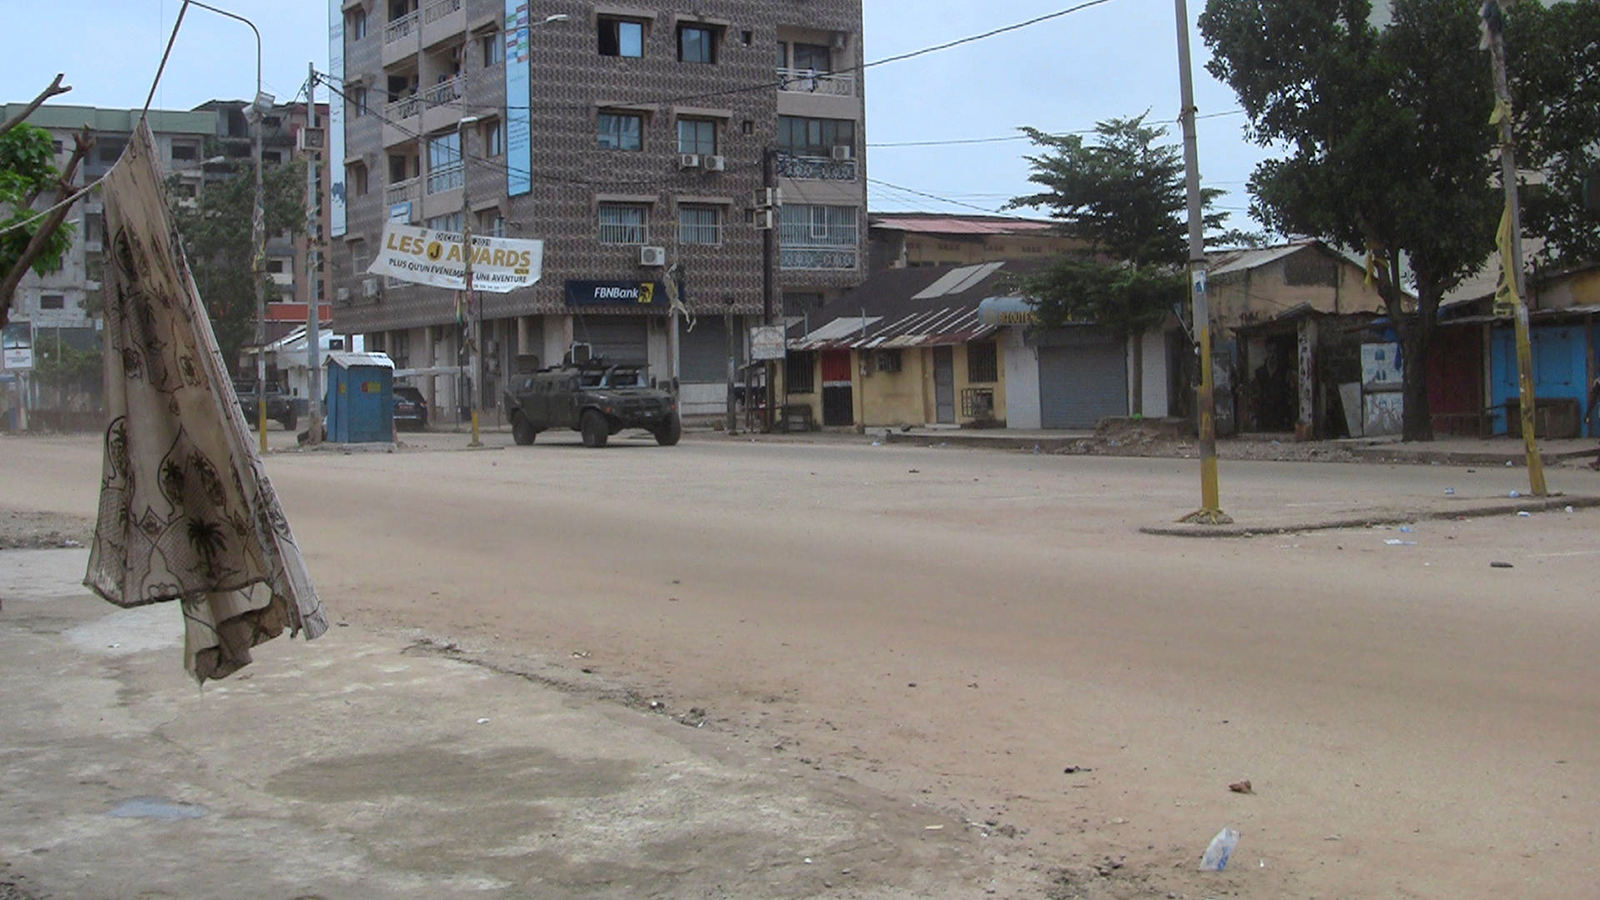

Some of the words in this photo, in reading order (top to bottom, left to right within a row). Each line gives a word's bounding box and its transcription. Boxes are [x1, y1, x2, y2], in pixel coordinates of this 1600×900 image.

[387, 233, 425, 256] LES
[446, 244, 531, 268] AWARDS
[389, 258, 407, 268] PLUS
[408, 262, 430, 273] QU'UN
[476, 272, 490, 282] UNE
[491, 273, 527, 284] AVENTURE
[594, 287, 639, 299] FBNBank
